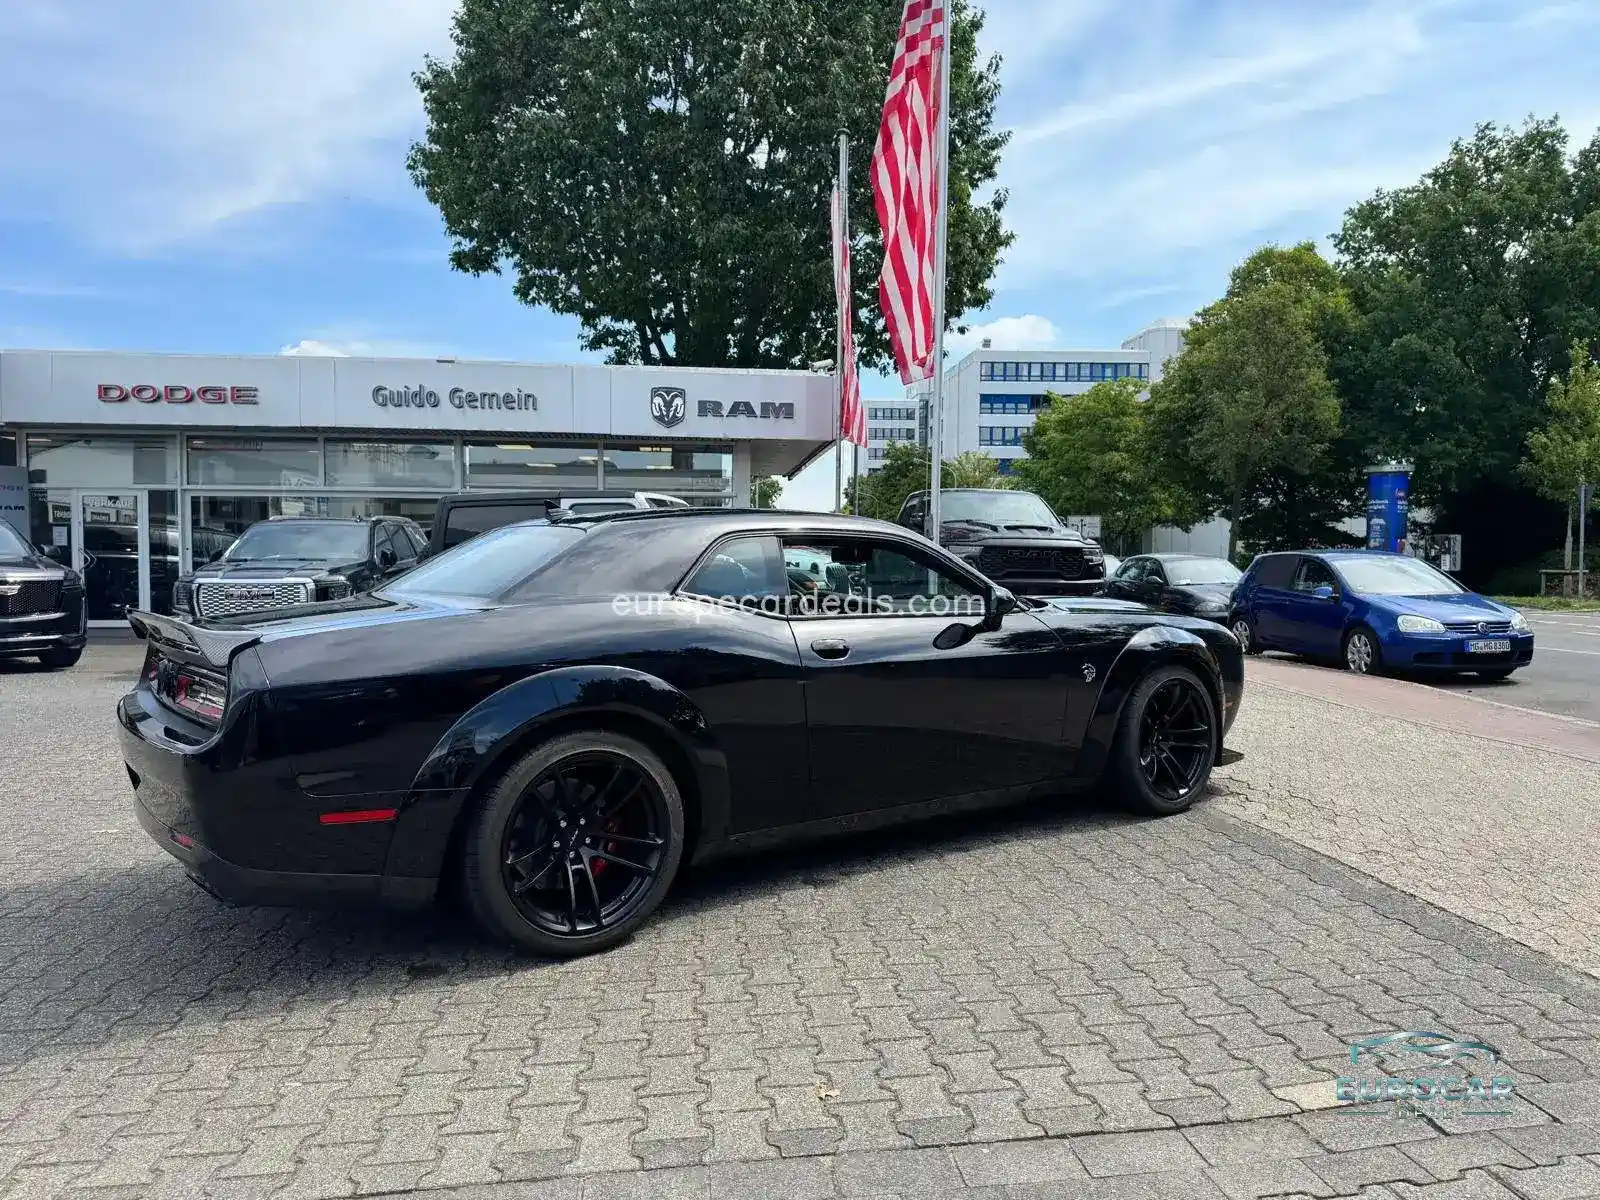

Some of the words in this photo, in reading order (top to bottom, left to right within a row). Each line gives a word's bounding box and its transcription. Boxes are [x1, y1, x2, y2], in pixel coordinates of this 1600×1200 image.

[97, 384, 259, 405] DODGE
[371, 384, 440, 408] Guido
[449, 388, 539, 411] Gemein
[697, 400, 795, 419] RAM
